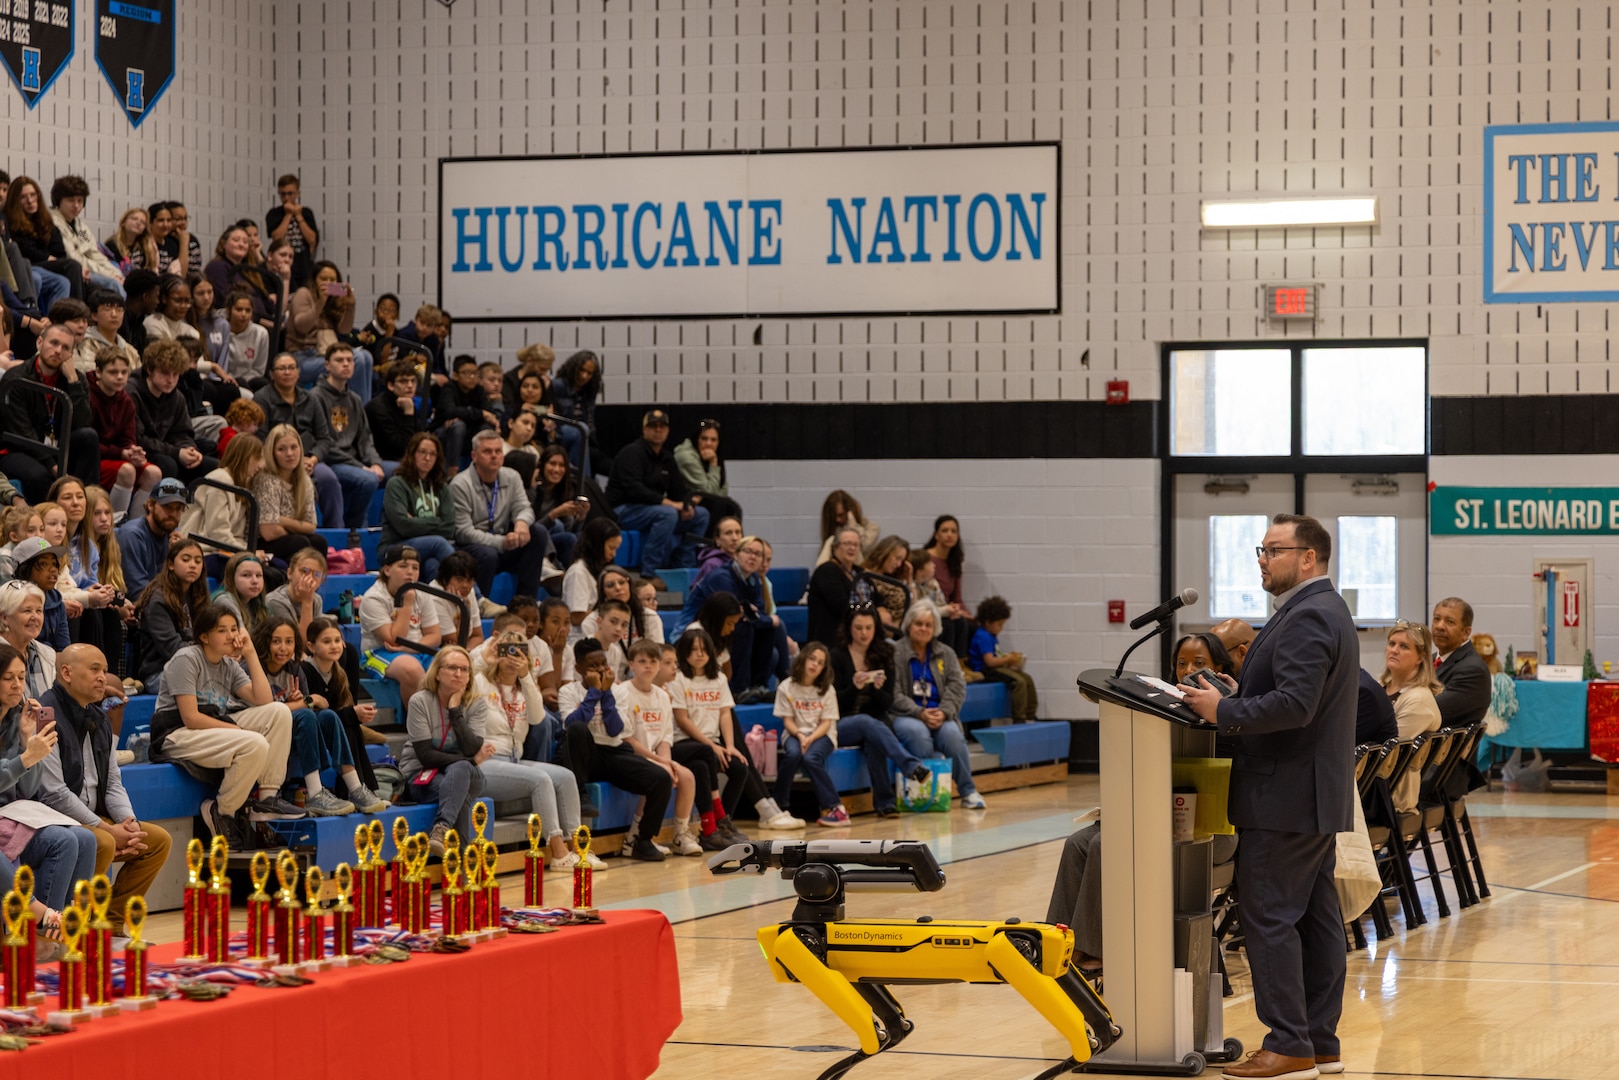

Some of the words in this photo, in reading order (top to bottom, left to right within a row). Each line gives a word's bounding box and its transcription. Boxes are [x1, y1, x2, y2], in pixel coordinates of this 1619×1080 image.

[52, 3, 69, 28] 2022
[100, 15, 116, 39] 2024
[13, 20, 30, 45] 2025
[1508, 153, 1600, 204] THE
[451, 199, 782, 273] HURRICANE
[826, 192, 1047, 264] NATION
[1275, 287, 1308, 315] EXIT
[1455, 499, 1488, 529] ST.
[1494, 499, 1603, 529] LEONARD
[795, 700, 824, 711] MESA
[834, 931, 863, 940] Boston
[863, 931, 903, 942] Dynamics
